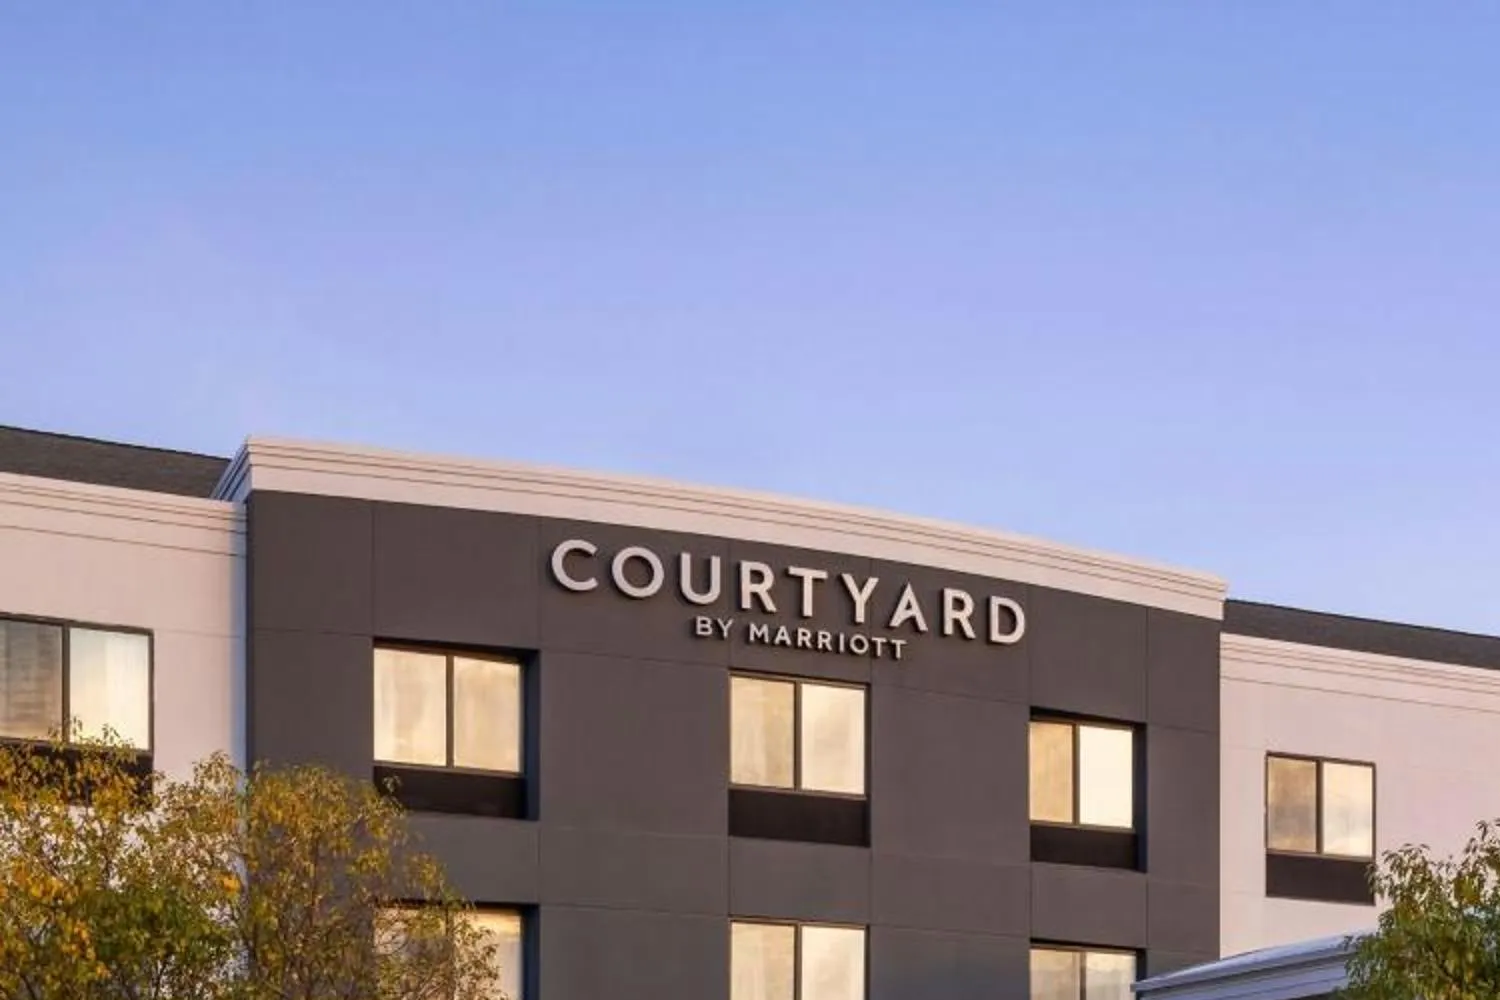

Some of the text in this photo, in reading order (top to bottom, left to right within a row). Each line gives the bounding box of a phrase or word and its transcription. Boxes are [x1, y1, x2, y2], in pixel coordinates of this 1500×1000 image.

[551, 539, 1026, 644] COURTYARD
[695, 616, 907, 660] BY MARRIOTT
